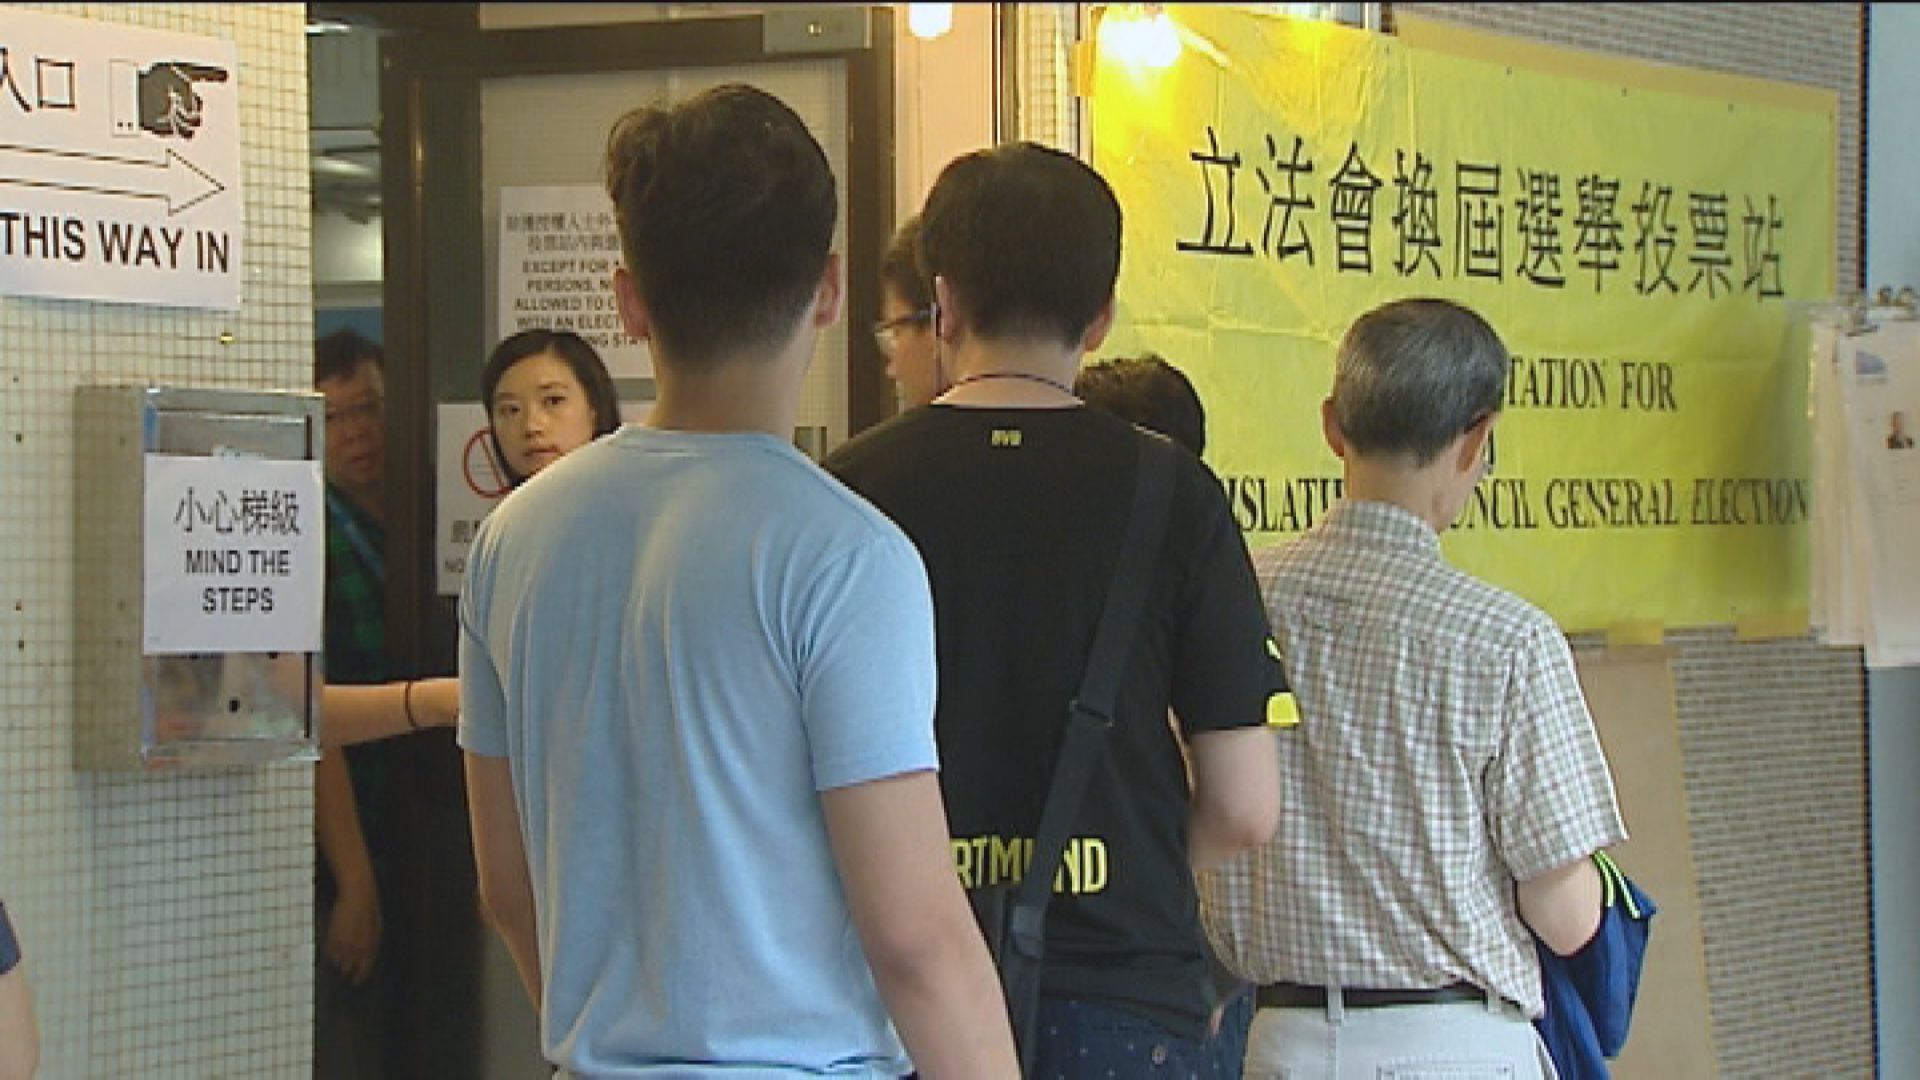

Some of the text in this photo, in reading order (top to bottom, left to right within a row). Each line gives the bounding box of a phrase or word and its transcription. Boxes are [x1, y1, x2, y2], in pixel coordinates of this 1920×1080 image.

[1175, 126, 1786, 302] 立法會換屆選舉投票站
[0, 212, 229, 273] THIS WAY IN
[523, 260, 576, 274] EXCEPT
[580, 260, 609, 274] FOR
[514, 297, 582, 311] ALLOWED
[578, 316, 622, 330] ELECT
[1507, 357, 1678, 412] TATION FOR
[174, 486, 301, 535] 小心梯級
[1546, 477, 1682, 530] GENERAL
[1690, 477, 1810, 526] ELECTION
[185, 549, 291, 576] MIND THE
[202, 587, 274, 614] STEPS
[950, 833, 1108, 894] RTMND
